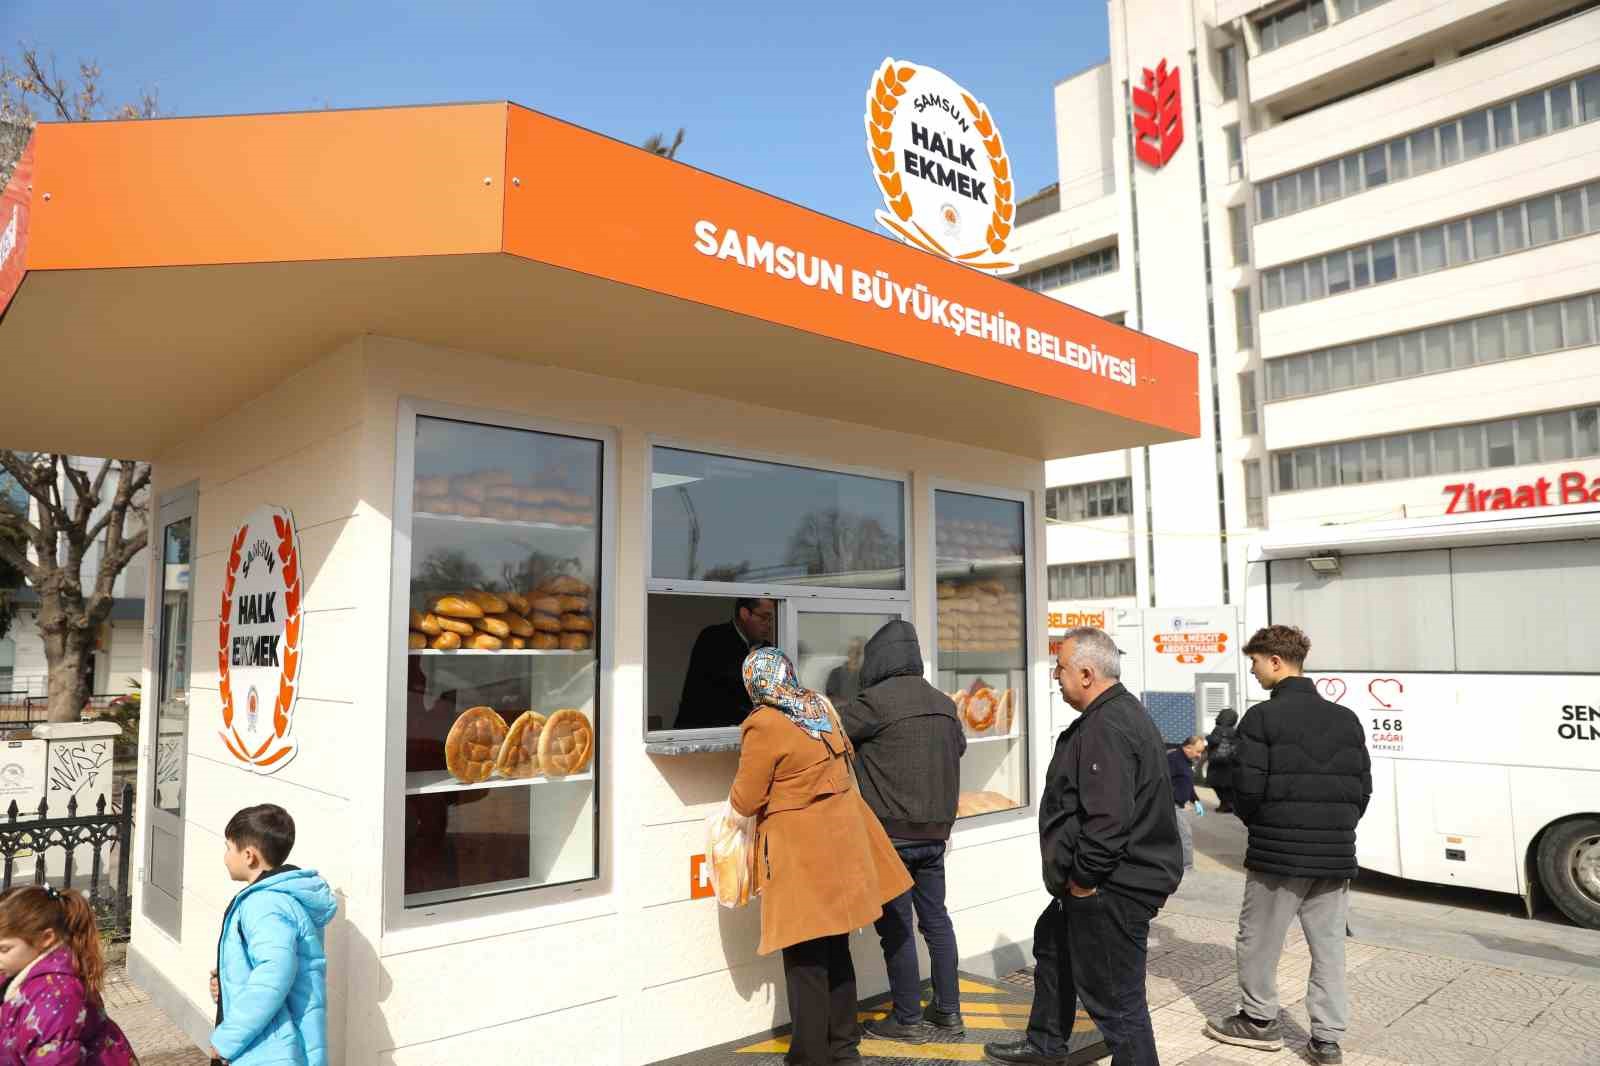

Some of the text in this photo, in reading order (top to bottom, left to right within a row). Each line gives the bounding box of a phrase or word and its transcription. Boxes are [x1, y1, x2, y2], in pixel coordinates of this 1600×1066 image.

[914, 93, 970, 133] SAMSUN
[911, 122, 977, 171] HALK
[904, 149, 988, 205] EKMEK
[694, 220, 1136, 387] SAMSUN BÜYÜKŞEHİR BELEDİYESİ
[1442, 477, 1551, 515] Ziraat
[243, 539, 275, 578] SAMSUN
[239, 592, 276, 624] HALK
[232, 635, 280, 667] EKMEK
[1372, 718, 1403, 731] 168
